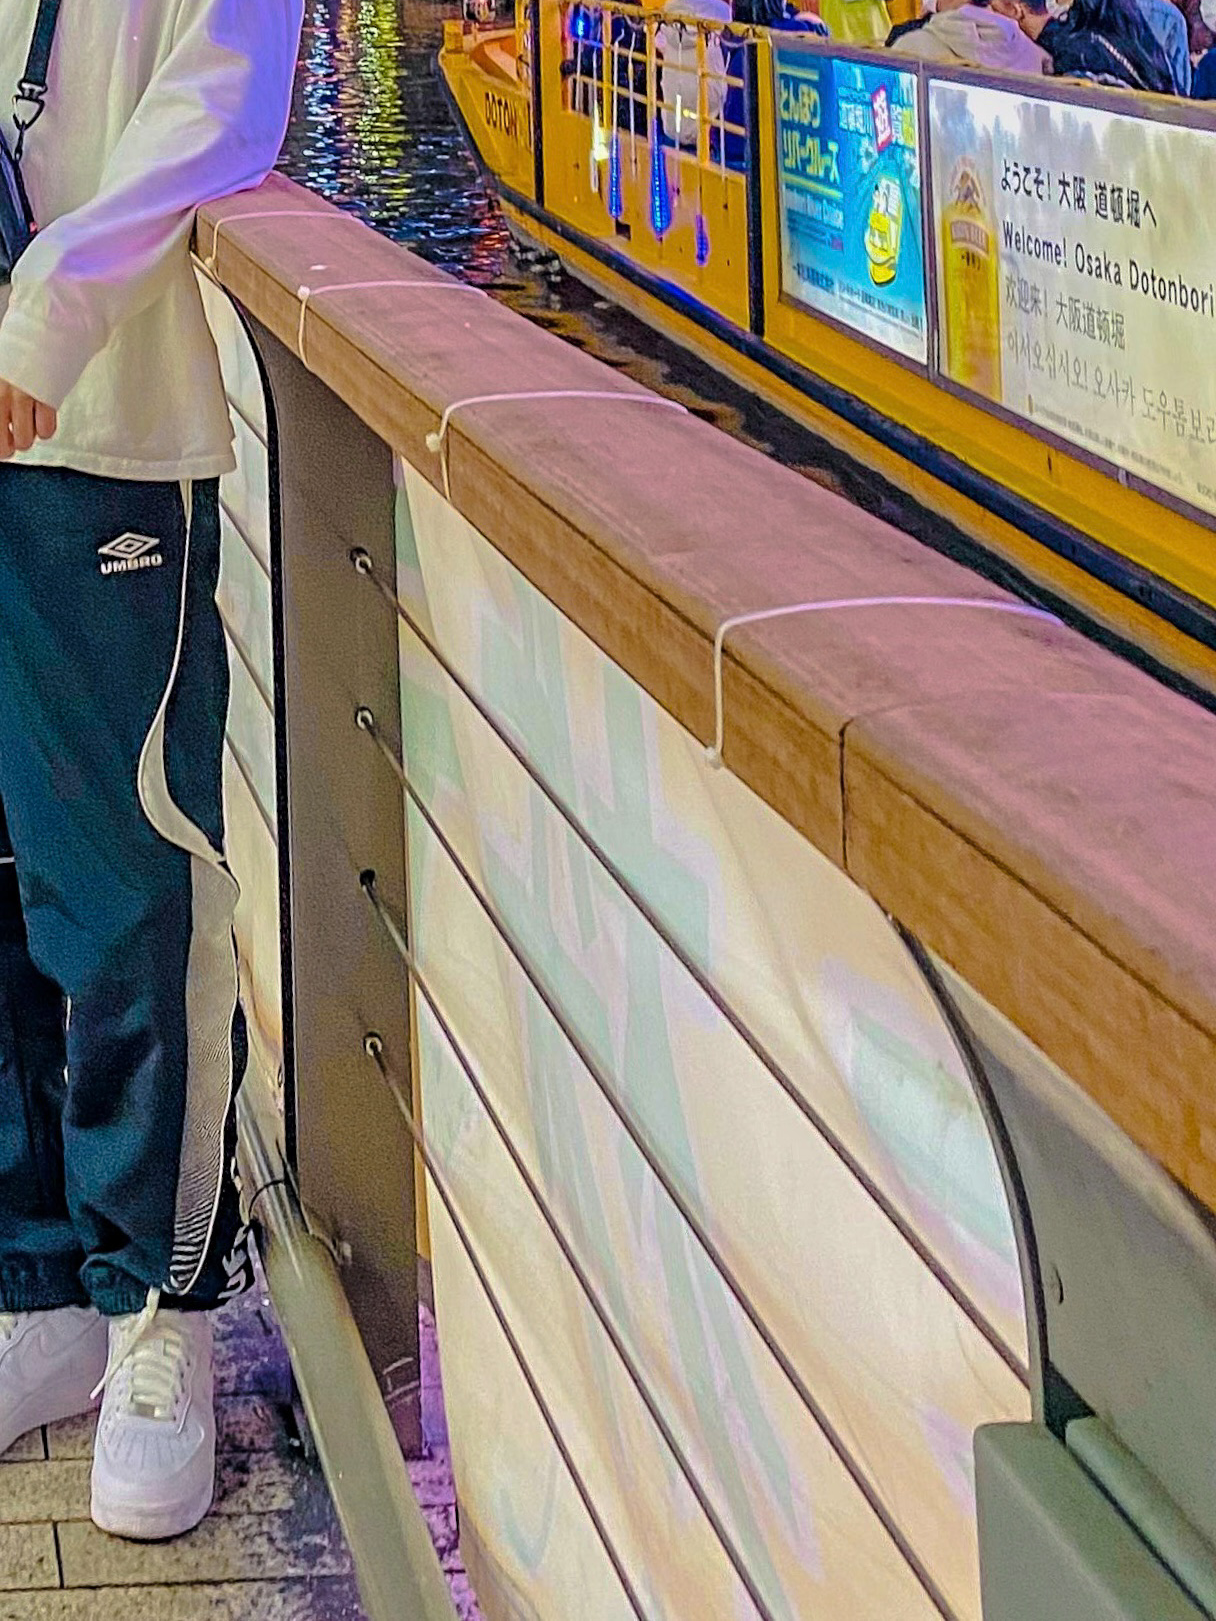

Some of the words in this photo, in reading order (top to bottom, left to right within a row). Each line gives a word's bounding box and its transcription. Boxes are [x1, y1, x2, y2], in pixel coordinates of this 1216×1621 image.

[1058, 172, 1087, 213] 大阪
[1094, 181, 1158, 229] 道頓堀へ
[1002, 220, 1068, 268] Welcome!
[1075, 243, 1123, 287] Osaka
[1130, 258, 1215, 318] Dotonbori
[1094, 366, 1135, 416] 오사카
[100, 553, 163, 576] UMBRO
